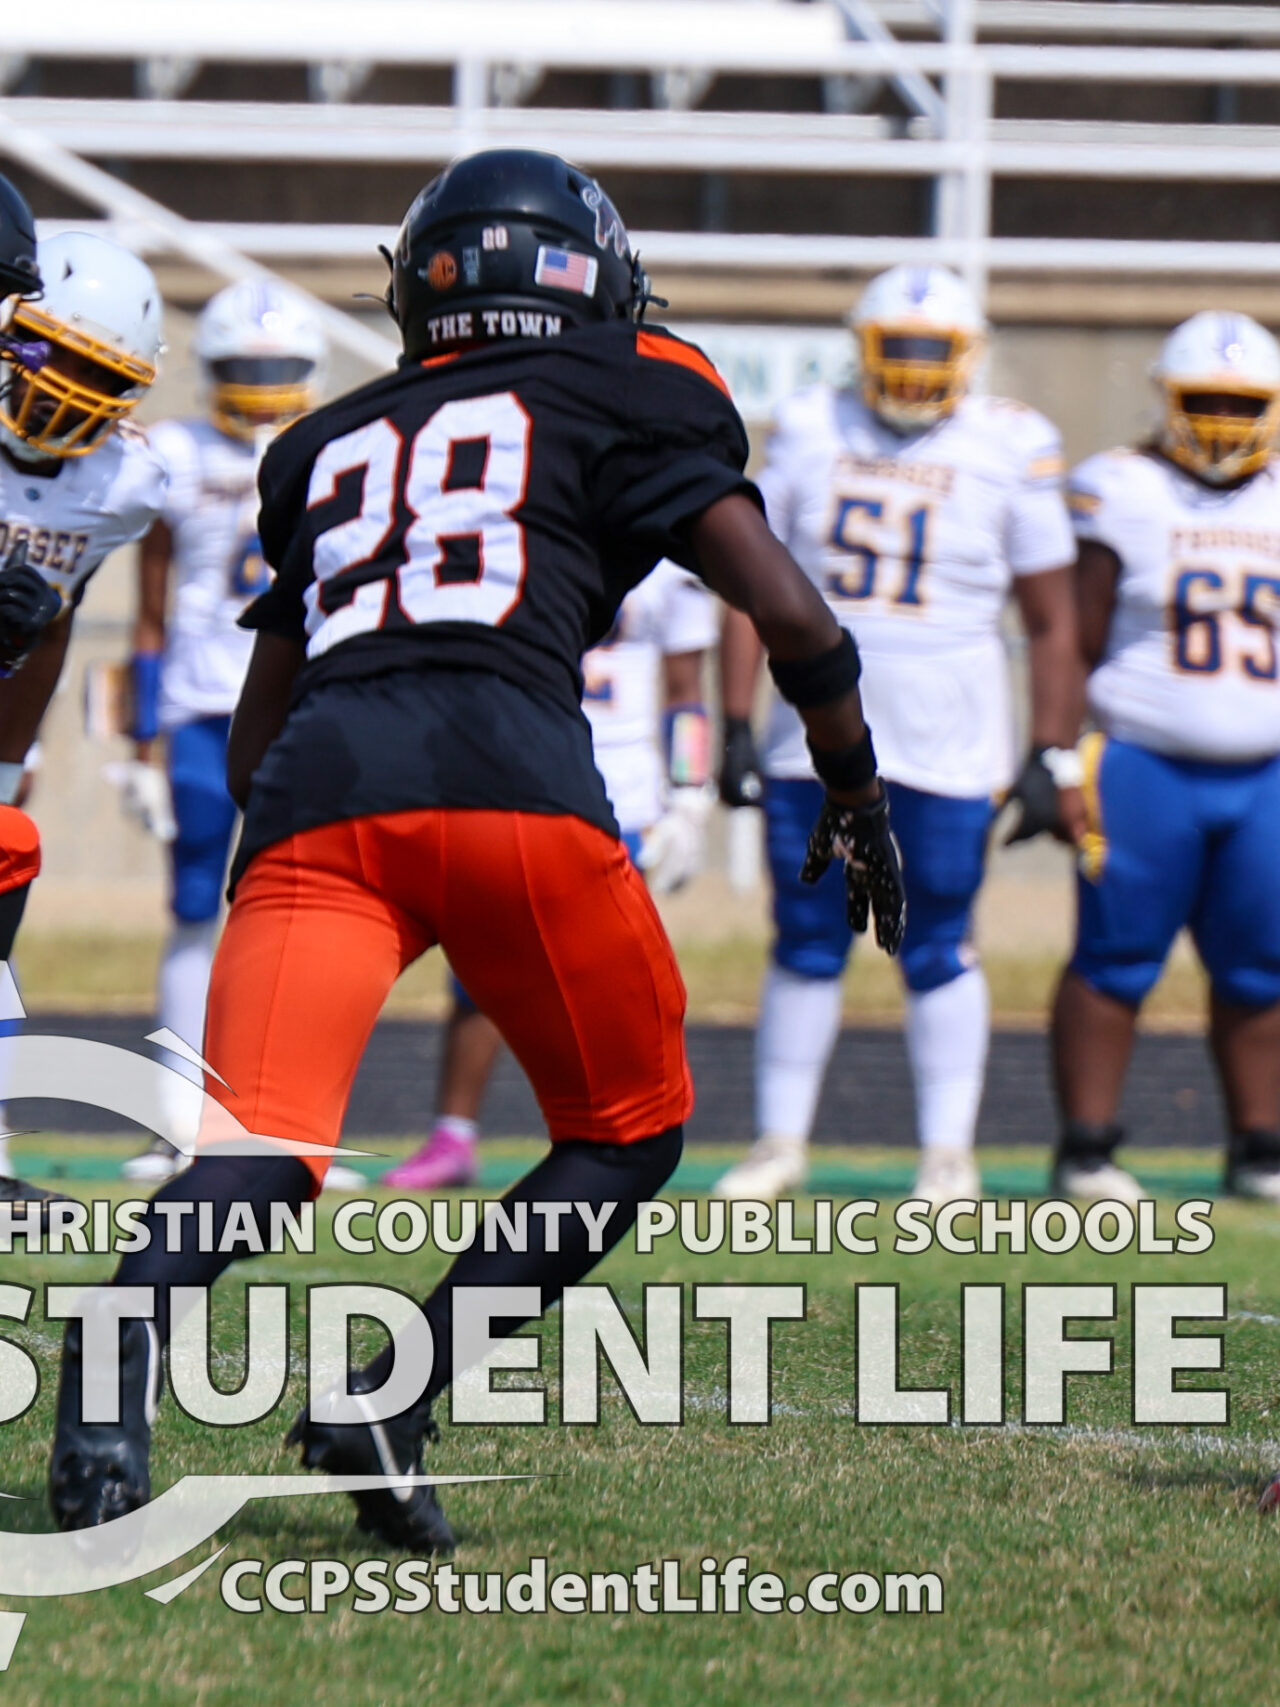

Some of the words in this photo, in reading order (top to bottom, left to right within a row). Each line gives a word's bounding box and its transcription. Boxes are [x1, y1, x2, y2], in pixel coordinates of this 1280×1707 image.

[427, 312, 473, 344] THE
[482, 310, 562, 338] TOWN
[303, 391, 533, 660] 28
[823, 496, 936, 613] 51
[1166, 564, 1280, 684] 65
